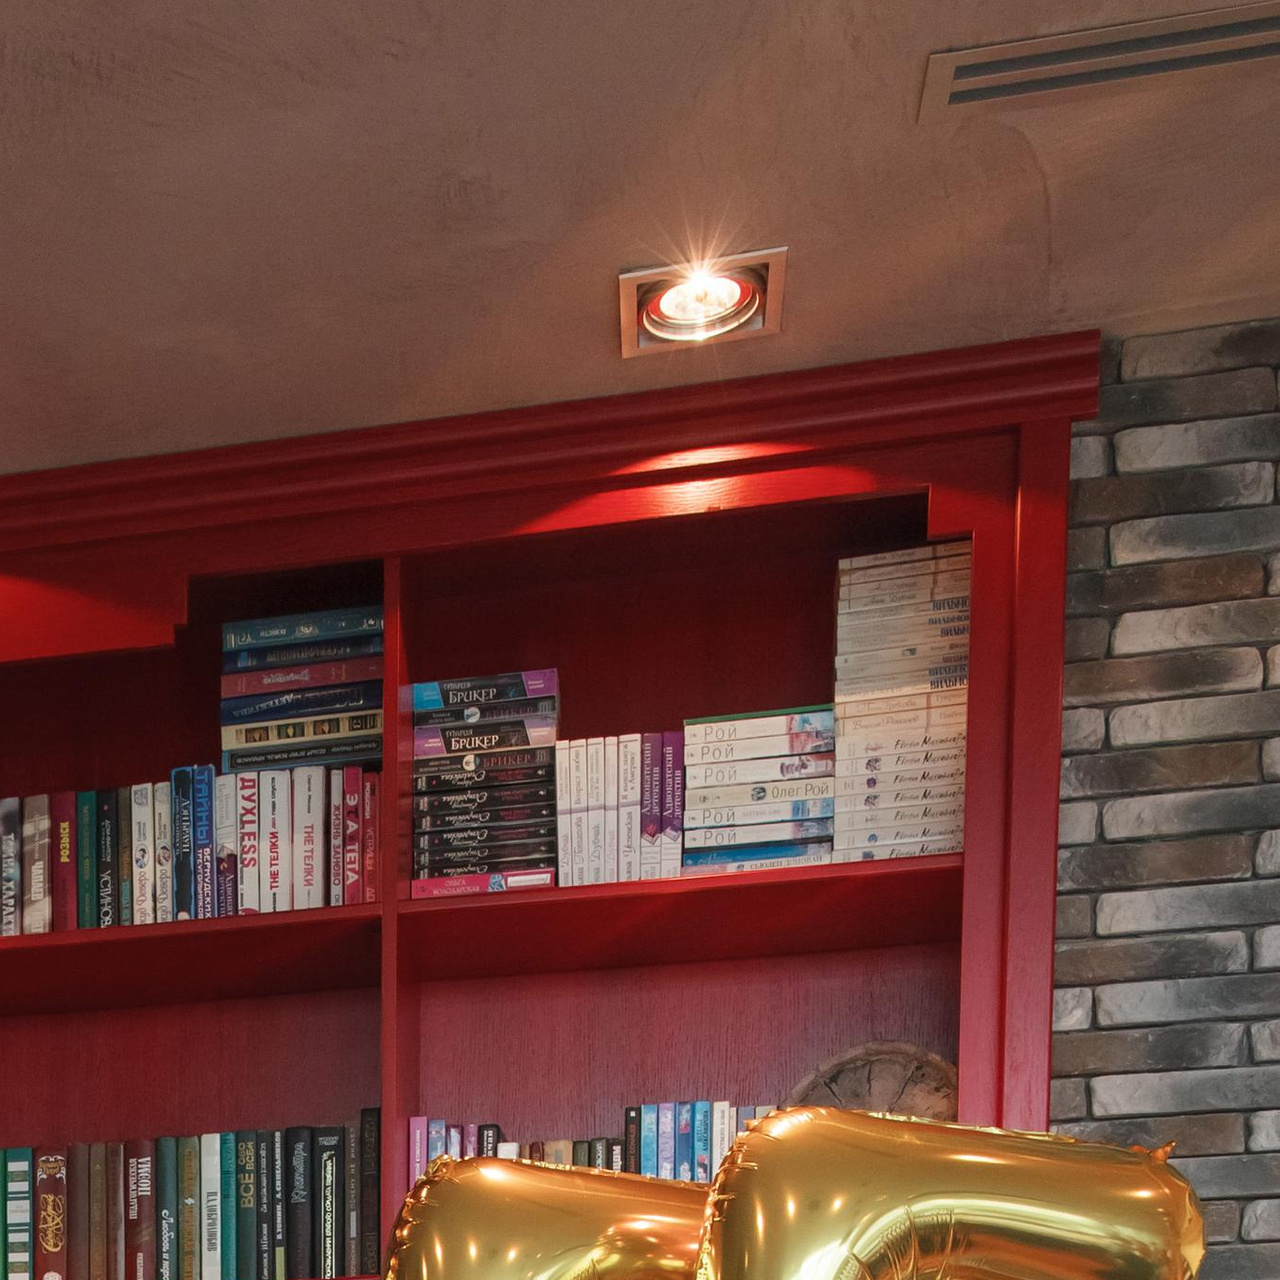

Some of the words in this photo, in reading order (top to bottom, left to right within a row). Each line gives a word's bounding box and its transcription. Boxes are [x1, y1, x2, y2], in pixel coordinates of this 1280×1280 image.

[449, 687, 497, 704] БРИКЕР
[451, 735, 499, 750] БРИКЕР
[239, 777, 257, 868] ДУХLESS
[100, 870, 112, 928] УСТИНОВ
[129, 1158, 137, 1220] ПЕДАГОГИЧЕСКАЯ
[138, 1156, 151, 1196] ПОЭМА
